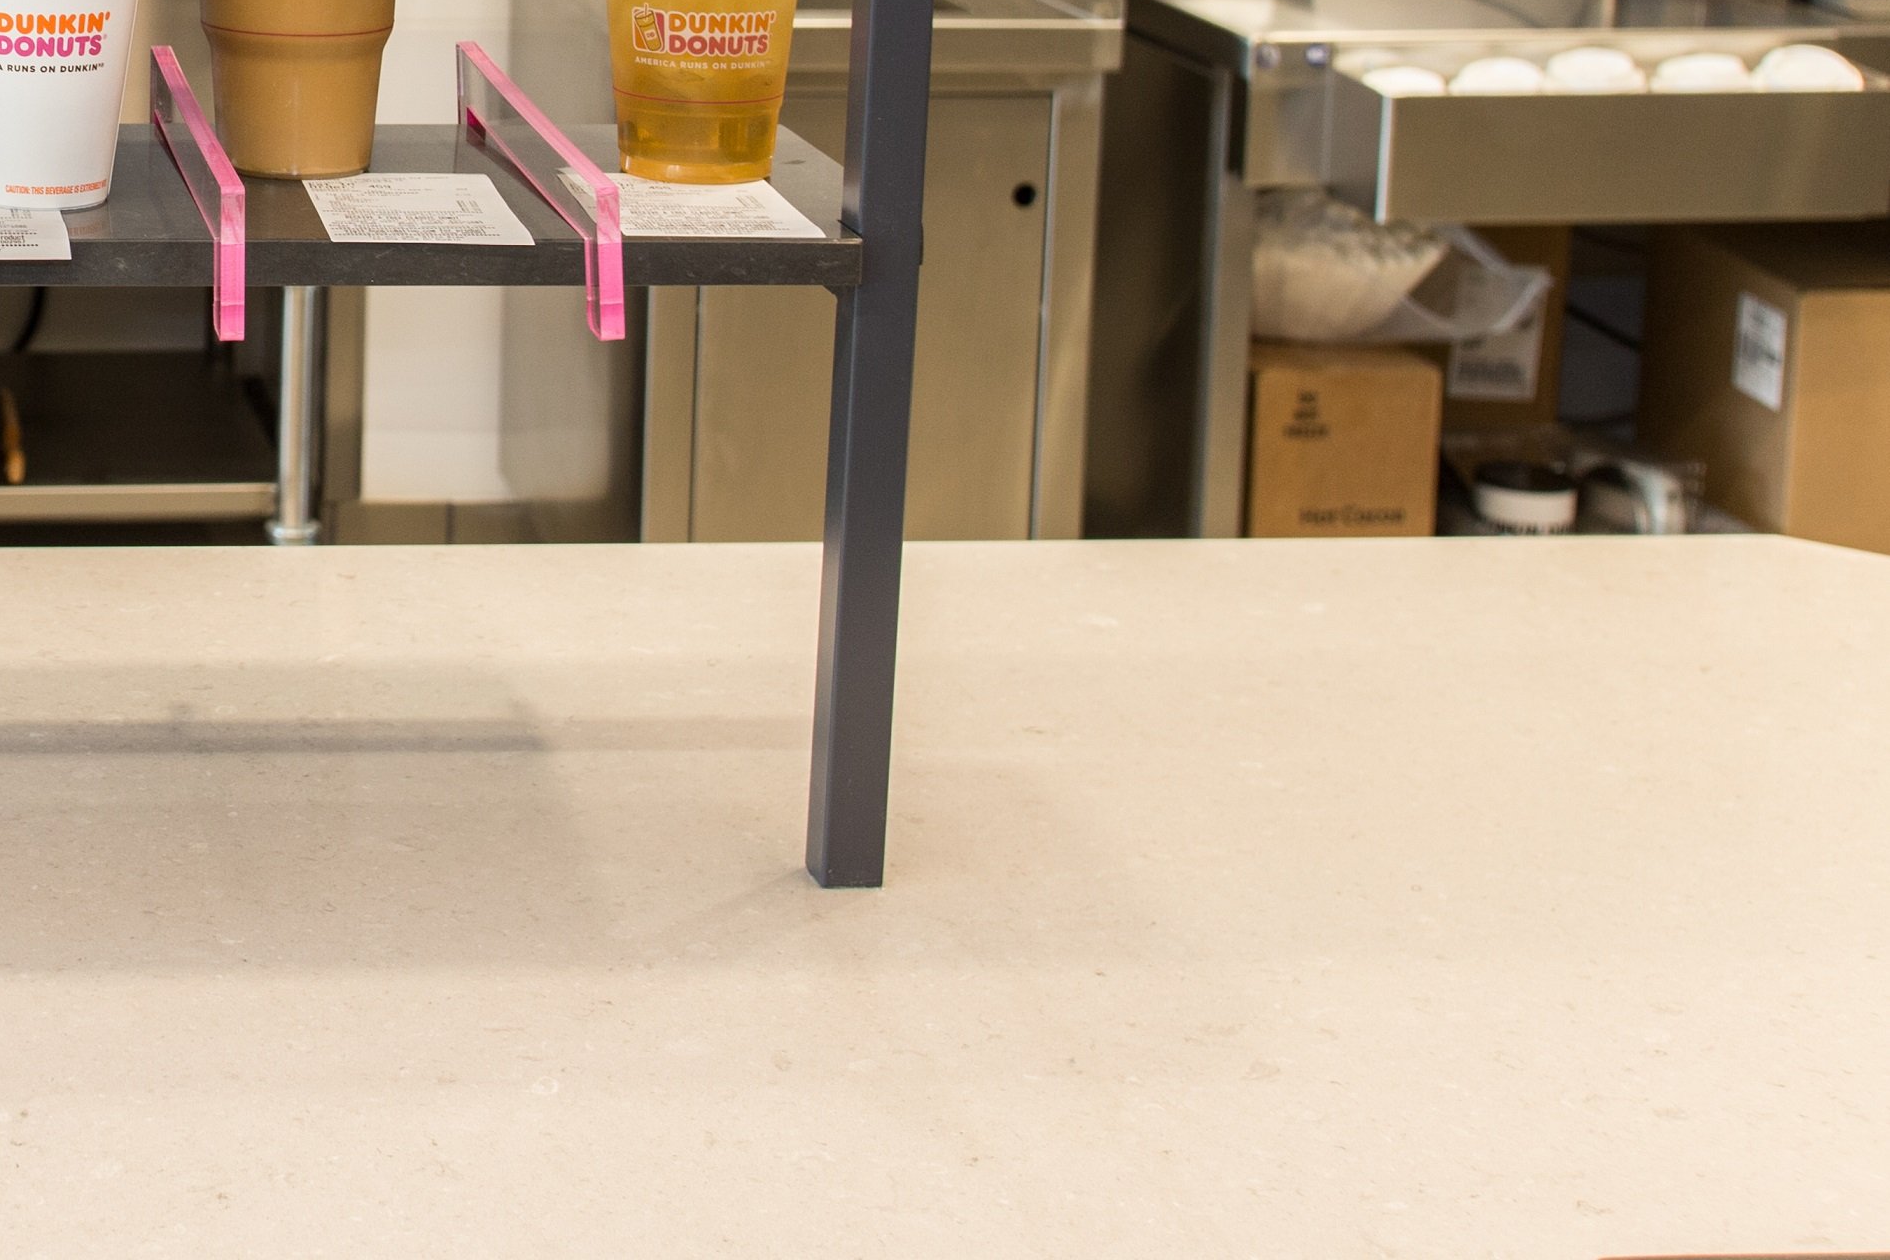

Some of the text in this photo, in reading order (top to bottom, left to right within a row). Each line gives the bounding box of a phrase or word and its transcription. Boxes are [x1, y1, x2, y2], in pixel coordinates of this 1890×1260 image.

[669, 12, 776, 34] DUNKIN'
[669, 34, 769, 55] DONUTS
[7, 64, 36, 73] RUNS
[40, 64, 56, 73] ON
[635, 56, 676, 68] AMERICA
[680, 61, 708, 69] RUNS
[712, 61, 727, 69] ON
[5, 184, 30, 195] CAUTION:
[31, 186, 44, 195] THIS
[45, 186, 73, 195] BEVERAGE
